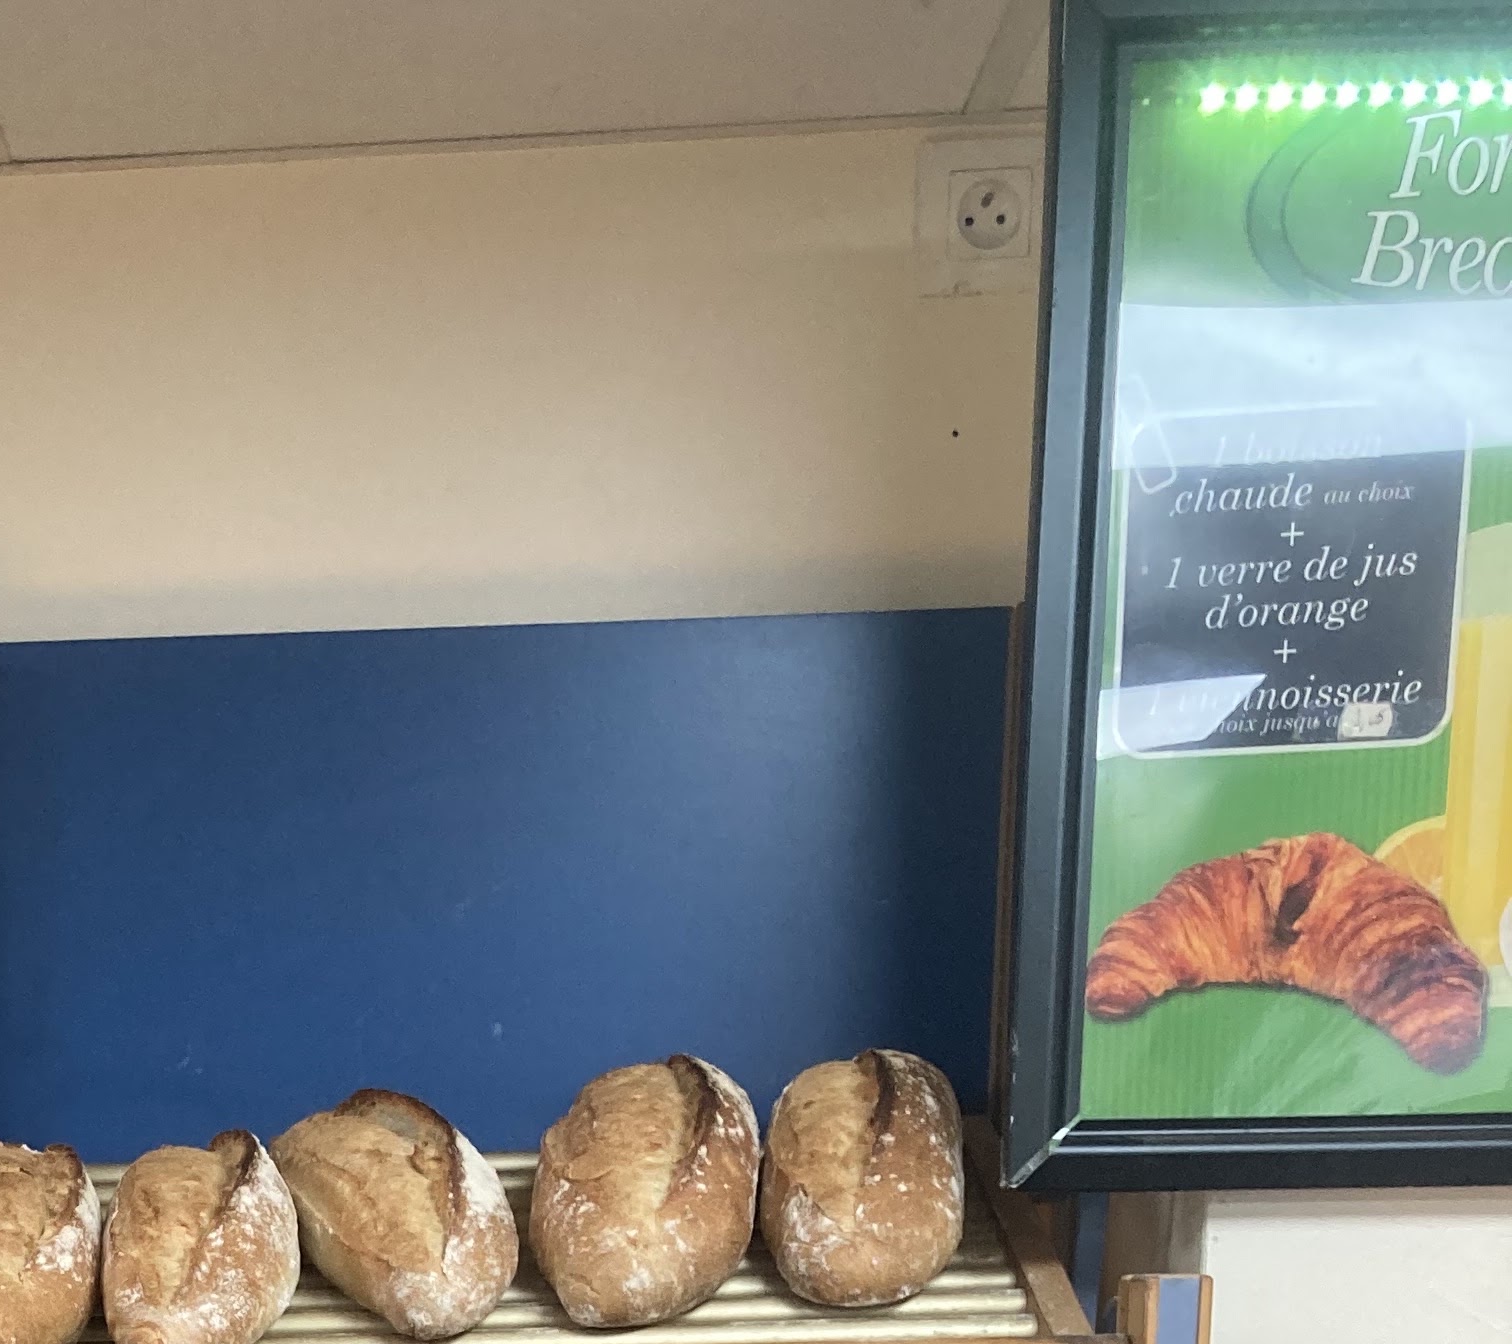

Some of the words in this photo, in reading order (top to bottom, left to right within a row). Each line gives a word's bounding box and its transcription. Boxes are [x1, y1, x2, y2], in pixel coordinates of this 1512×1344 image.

[1174, 473, 1313, 513] chaude
[1324, 488, 1350, 503] au
[1358, 482, 1415, 502] choix
[1165, 558, 1181, 588] 1
[1198, 560, 1291, 586] verre
[1303, 546, 1347, 581] de
[1354, 543, 1417, 586] jus
[1205, 593, 1369, 630] d'orange
